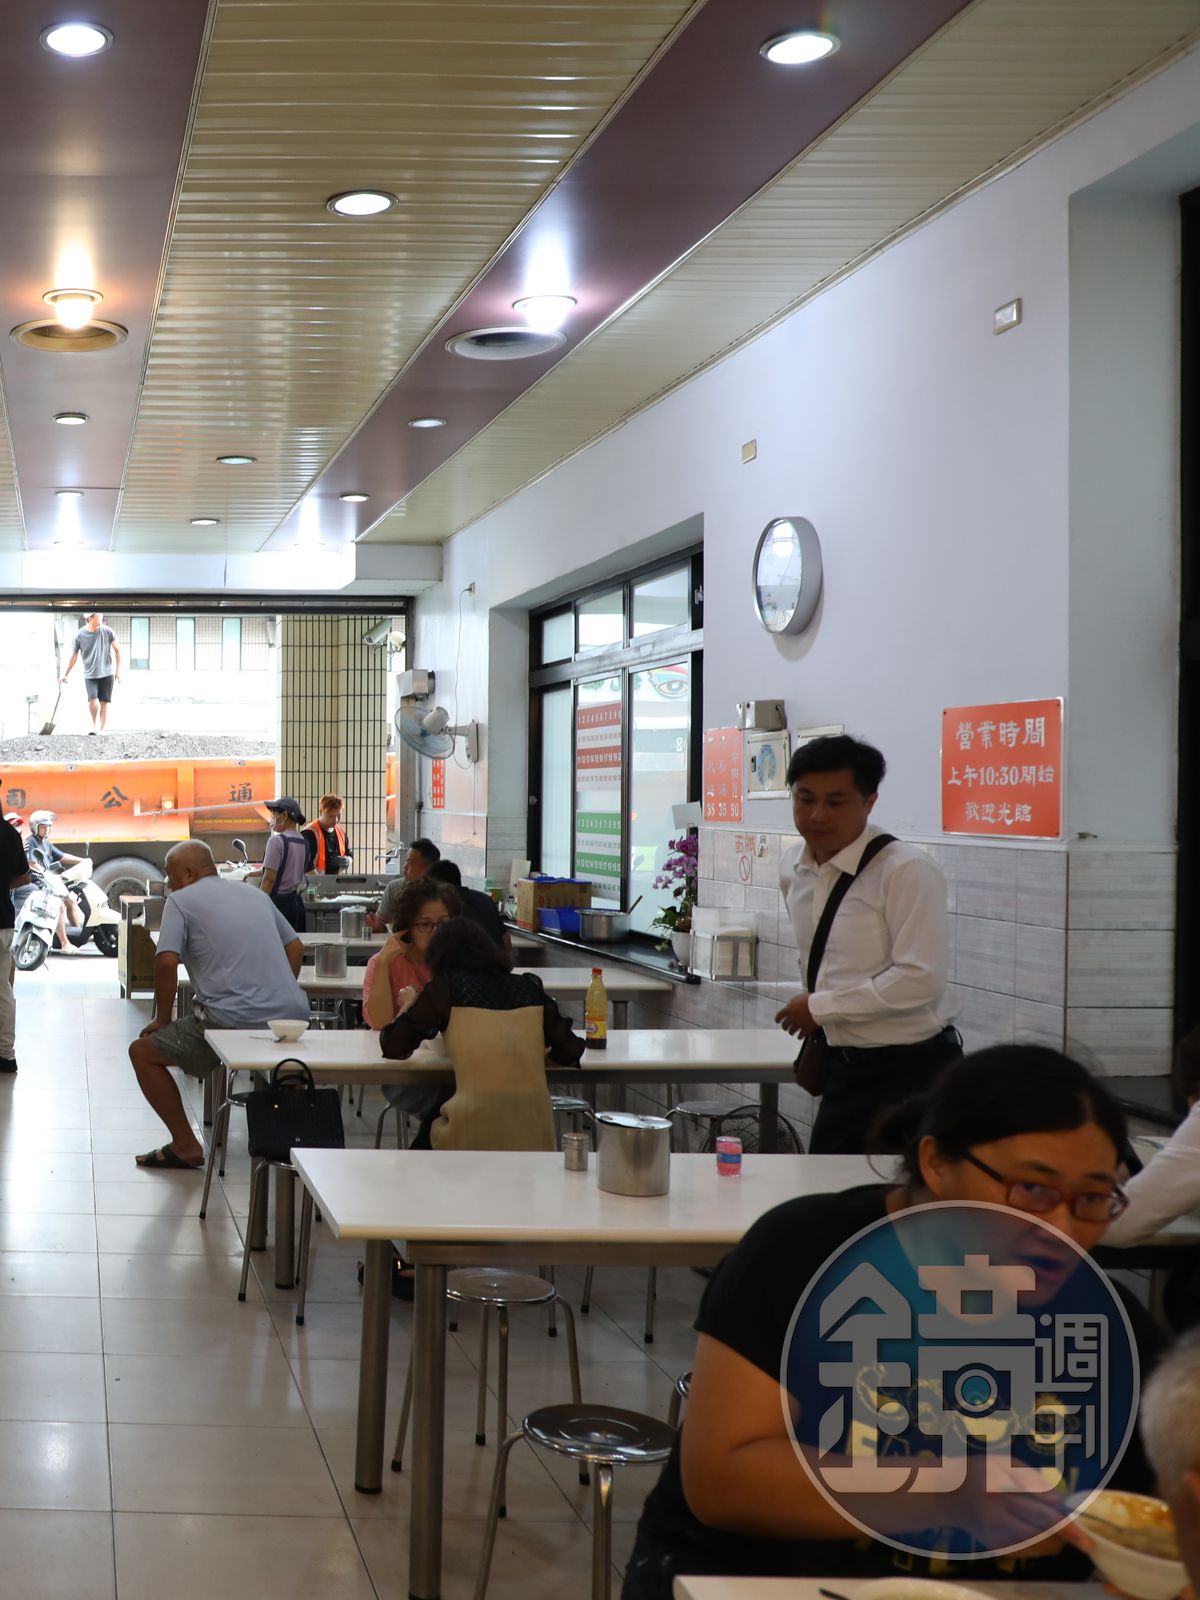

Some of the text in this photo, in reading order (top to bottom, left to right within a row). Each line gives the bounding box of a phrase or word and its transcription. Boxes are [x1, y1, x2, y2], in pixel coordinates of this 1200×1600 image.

[955, 716, 1046, 750] 營業時間
[947, 765, 1055, 788] 上午10:30開始
[730, 802, 739, 817] 50
[965, 801, 1032, 826] 歡迎光臨
